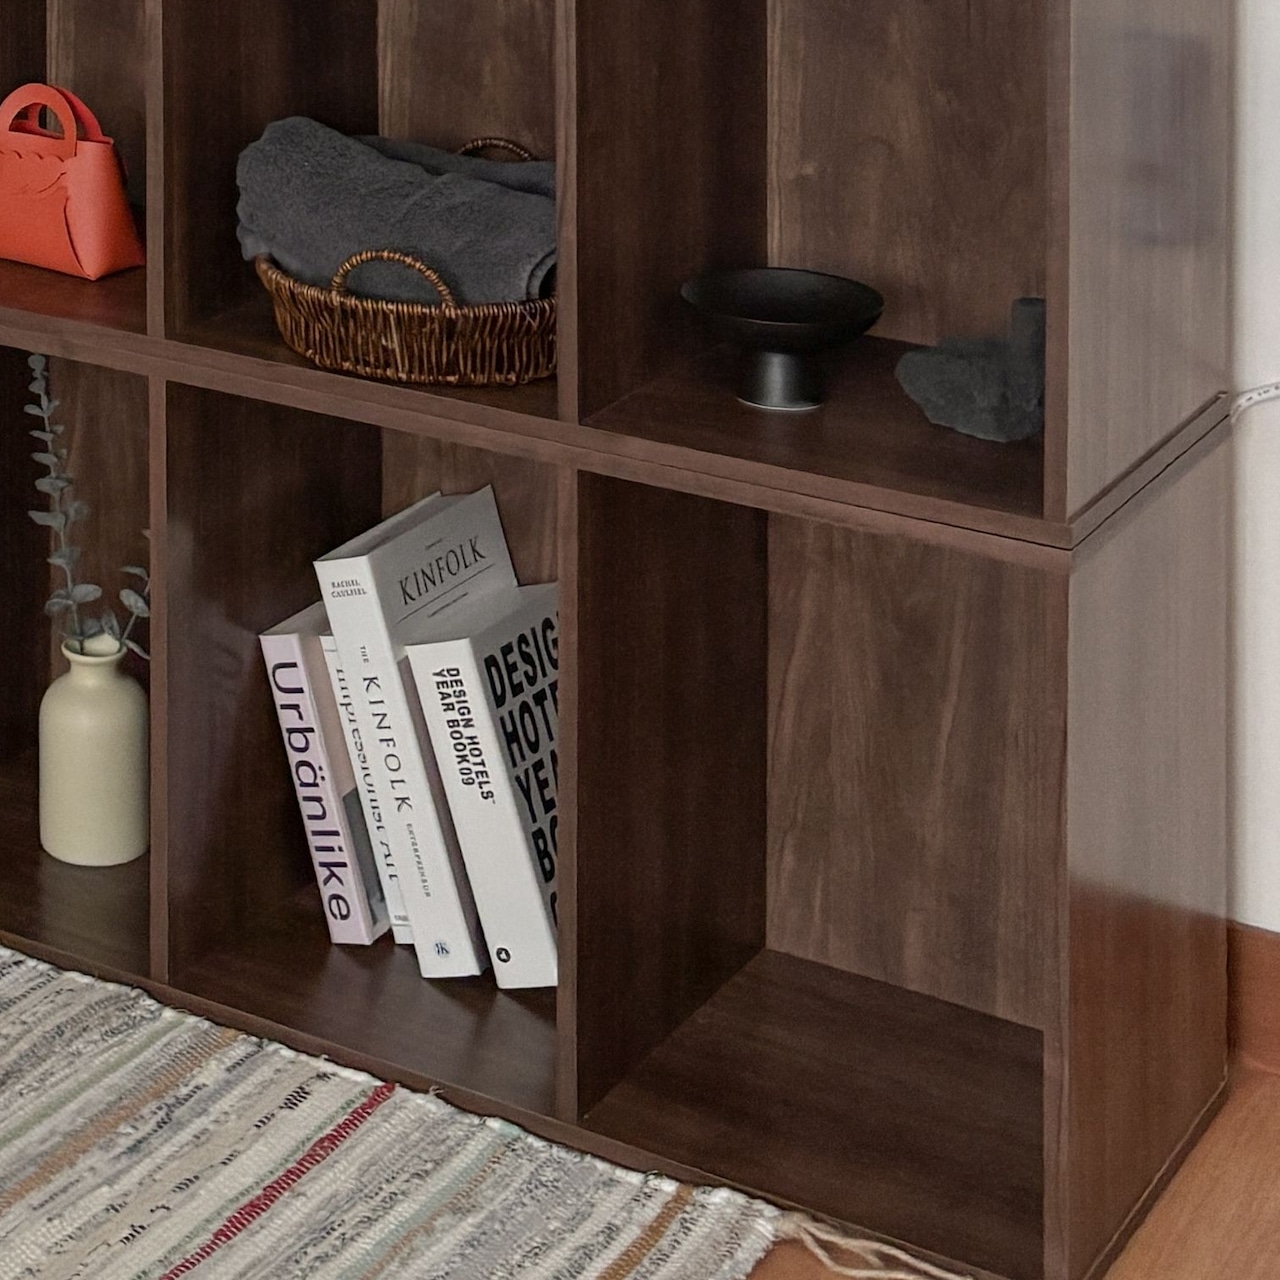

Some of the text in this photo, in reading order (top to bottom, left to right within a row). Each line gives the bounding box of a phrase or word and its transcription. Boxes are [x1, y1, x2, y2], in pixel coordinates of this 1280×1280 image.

[399, 535, 486, 605] KINFOLK
[432, 668, 456, 713] YEAR
[446, 667, 475, 729] DESIGN
[484, 612, 558, 708] DESIG
[363, 675, 412, 813] KINFOLK
[271, 661, 351, 921] Urbänlike
